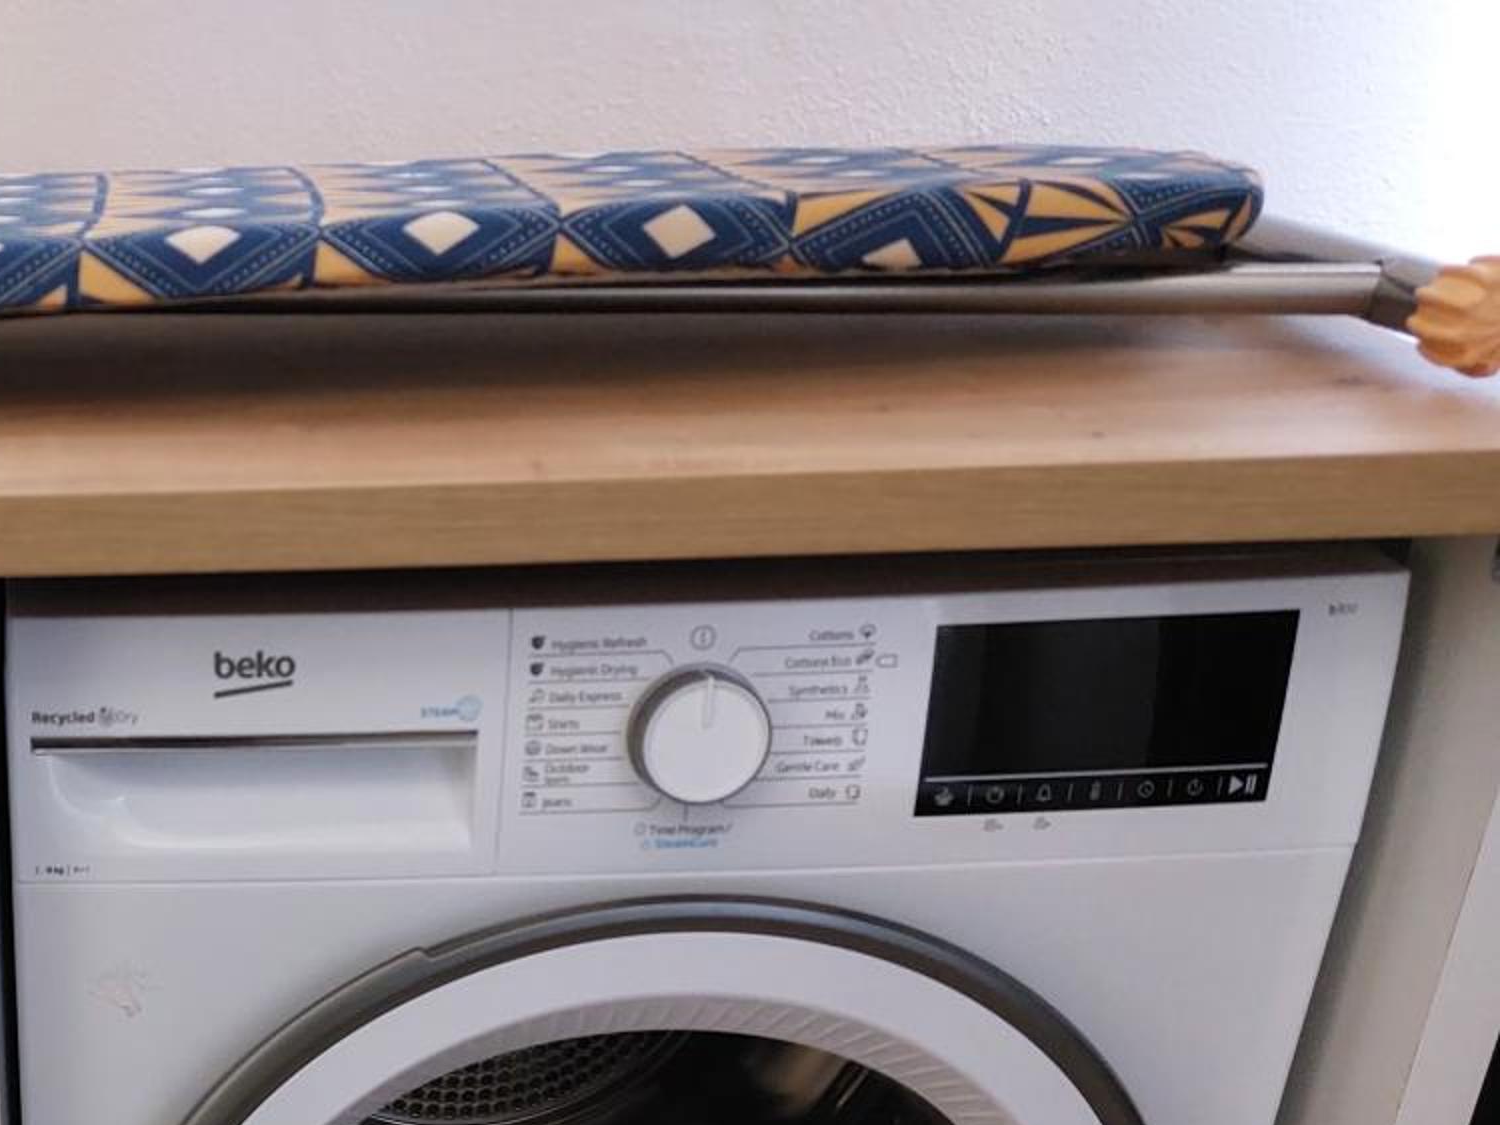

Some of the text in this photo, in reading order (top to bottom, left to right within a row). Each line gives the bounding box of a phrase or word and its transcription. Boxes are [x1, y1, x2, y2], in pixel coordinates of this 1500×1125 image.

[213, 649, 295, 680] beko
[31, 711, 95, 728] Recycled
[649, 823, 676, 835] Time
